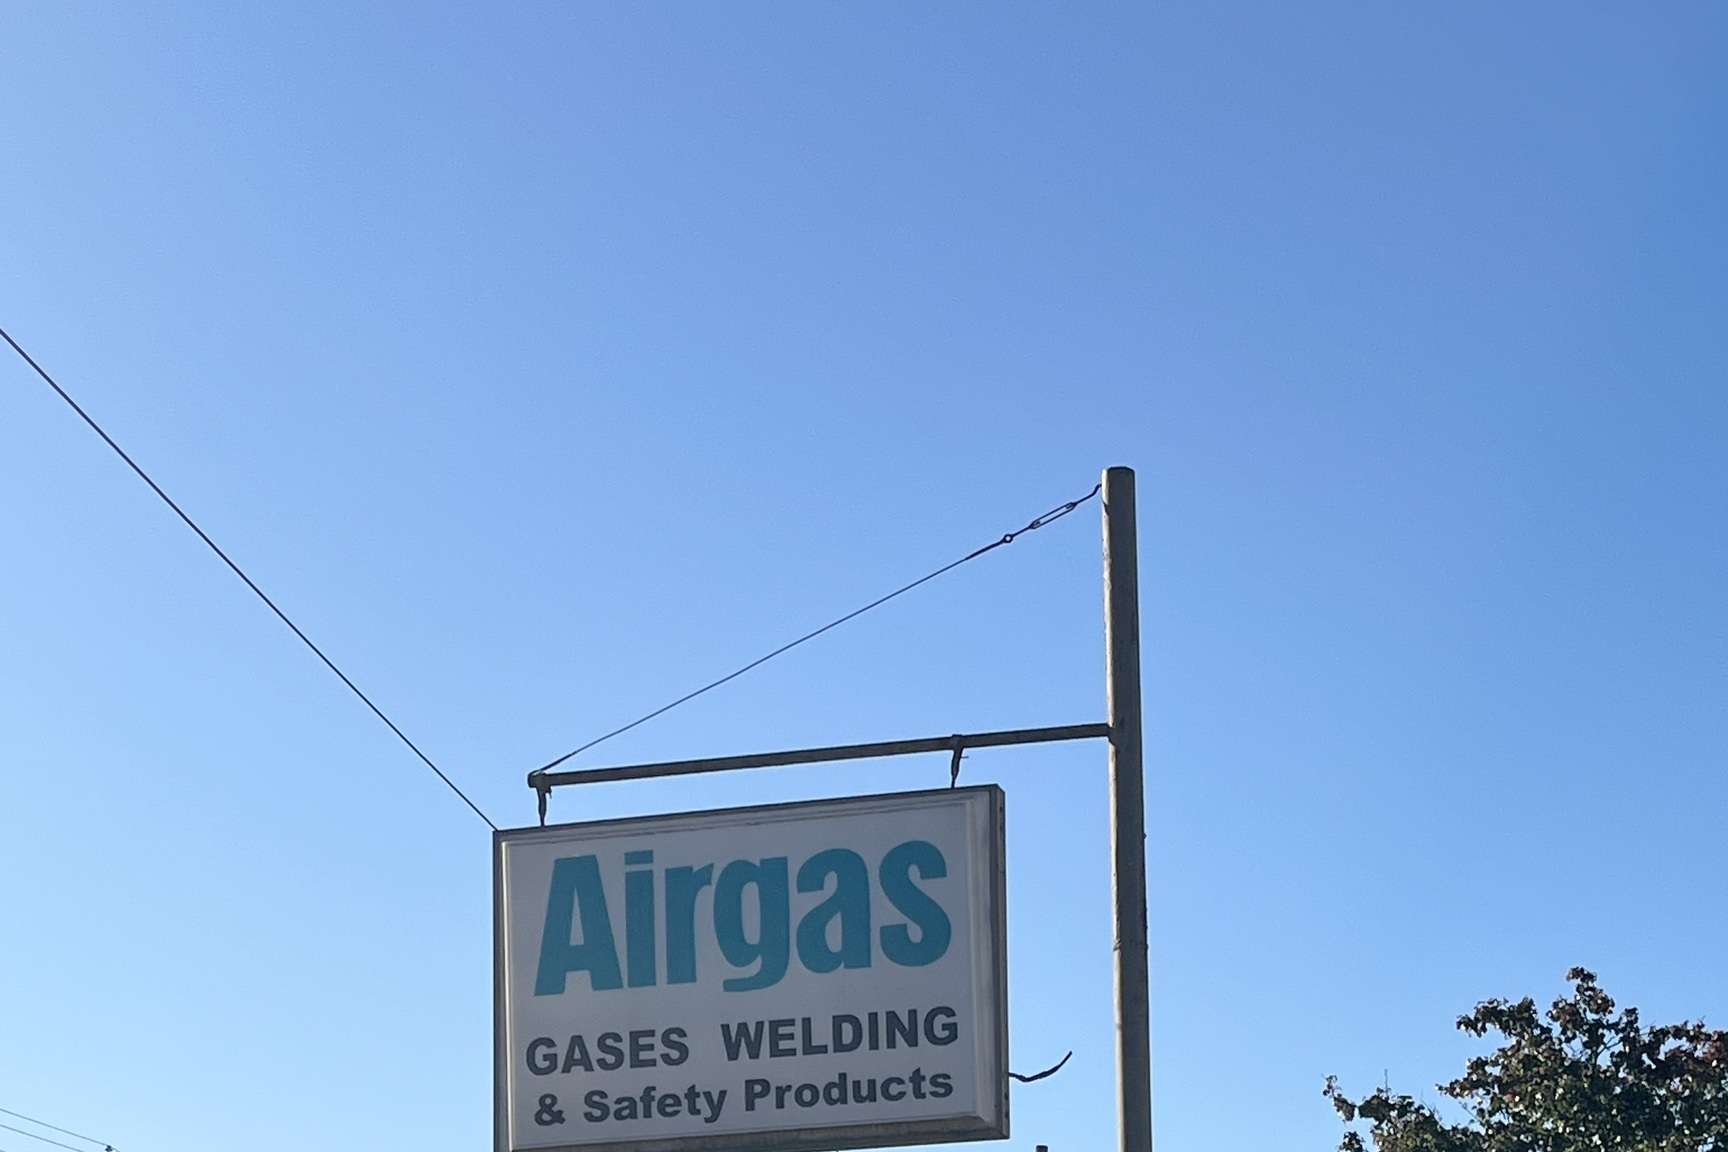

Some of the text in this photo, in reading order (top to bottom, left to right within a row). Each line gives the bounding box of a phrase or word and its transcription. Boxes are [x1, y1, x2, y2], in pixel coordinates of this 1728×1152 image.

[533, 840, 952, 997] Airgas
[525, 1006, 959, 1076] GASES WELDING
[534, 1067, 954, 1127] & Safety Products
